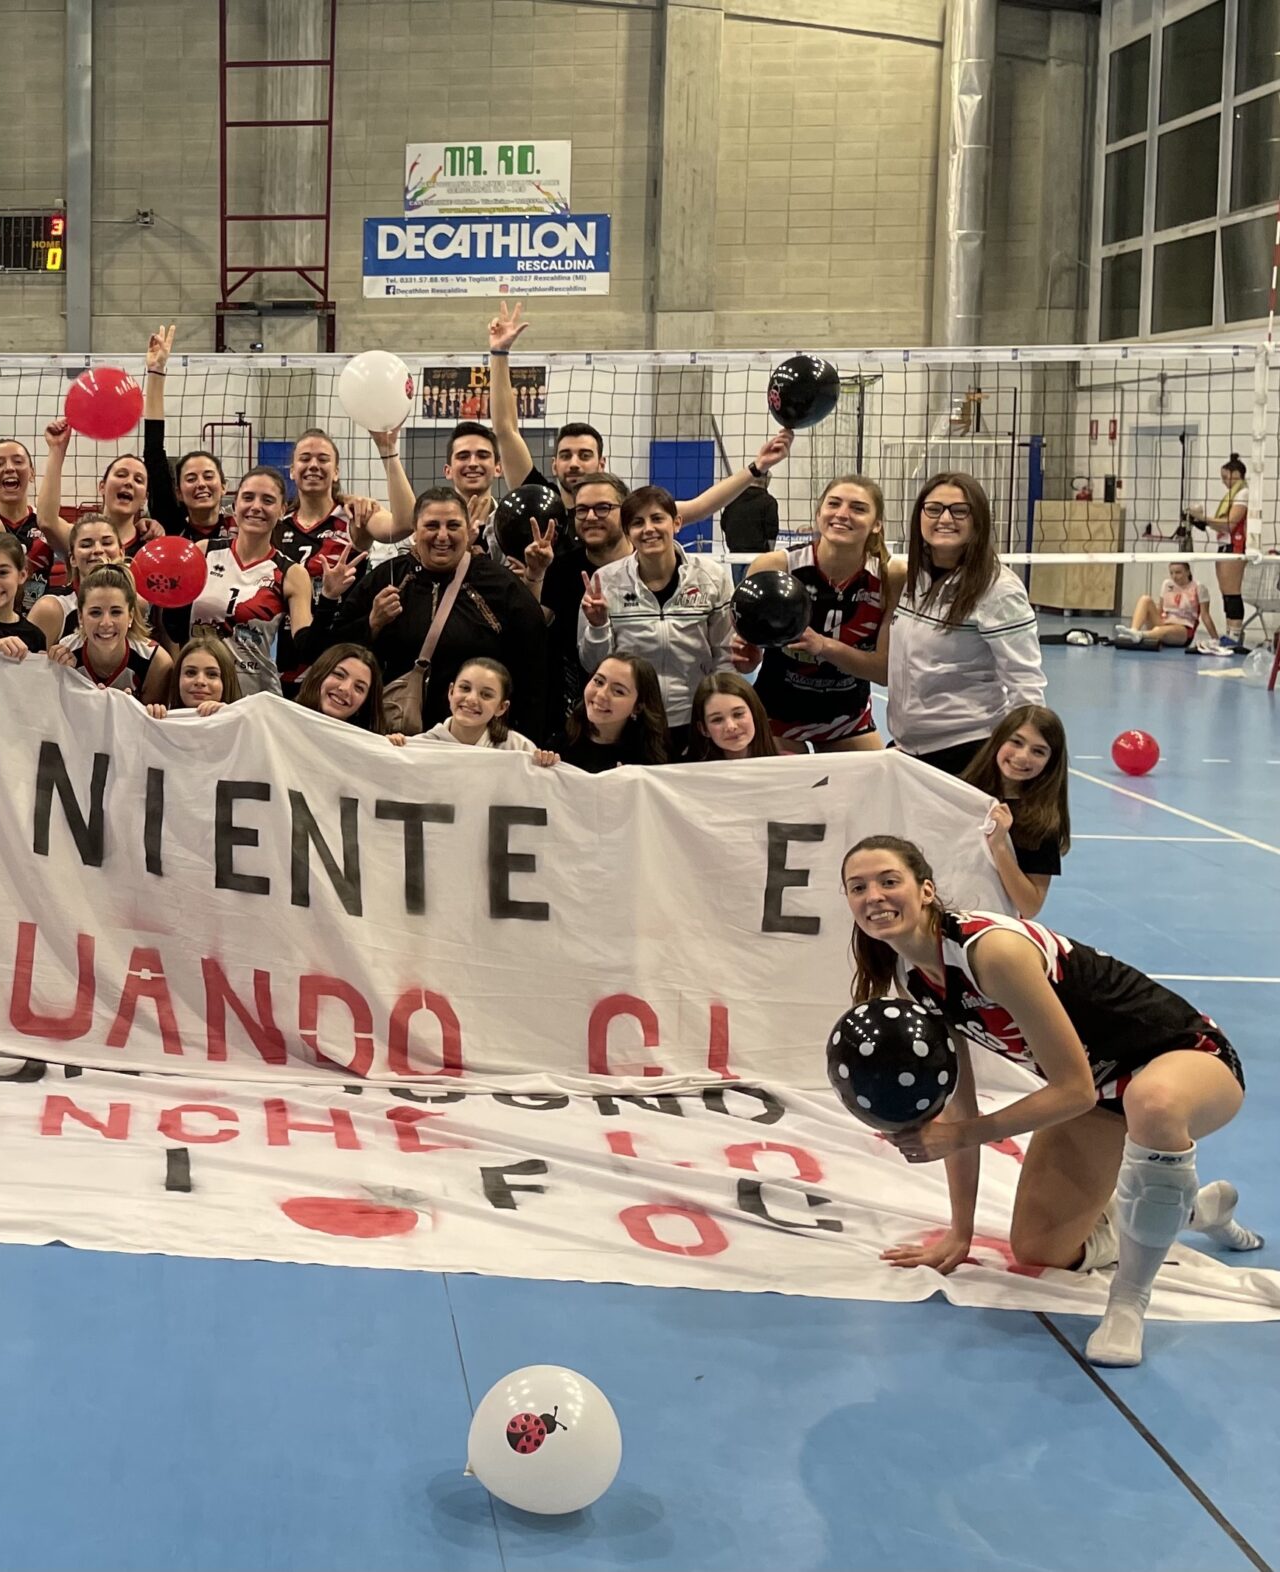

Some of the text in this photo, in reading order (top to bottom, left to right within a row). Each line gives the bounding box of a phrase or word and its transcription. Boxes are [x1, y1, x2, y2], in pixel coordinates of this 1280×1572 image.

[51, 218, 64, 235] 3
[377, 222, 597, 260] DECATHLON
[46, 248, 62, 270] 0
[517, 259, 595, 271] RESCALDINA
[298, 545, 312, 568] 7
[226, 587, 240, 615] 1
[240, 661, 260, 670] SRL
[32, 740, 550, 921] NIENTE
